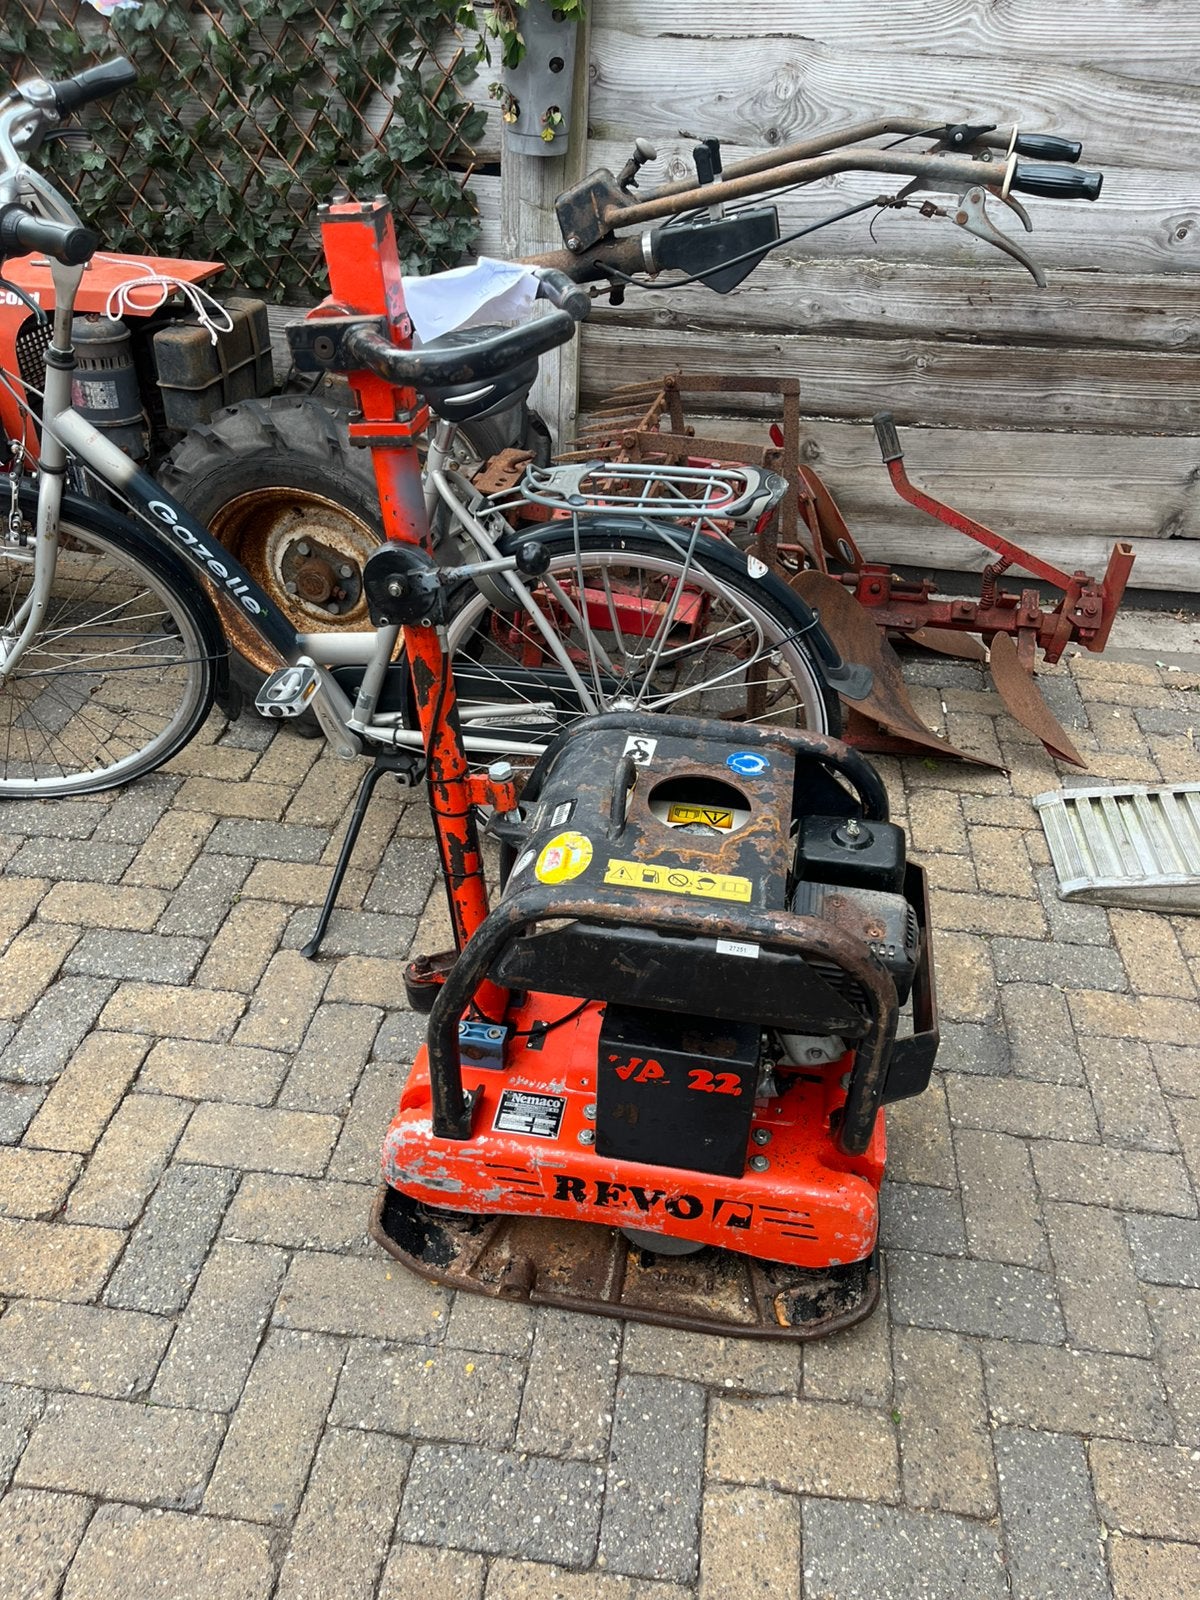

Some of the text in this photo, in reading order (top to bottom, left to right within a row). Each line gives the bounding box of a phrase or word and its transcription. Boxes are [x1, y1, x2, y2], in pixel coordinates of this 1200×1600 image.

[148, 501, 260, 614] Gazelle
[511, 1093, 560, 1108] Nemaco
[687, 1069, 742, 1096] 22
[553, 1175, 704, 1220] REVO
